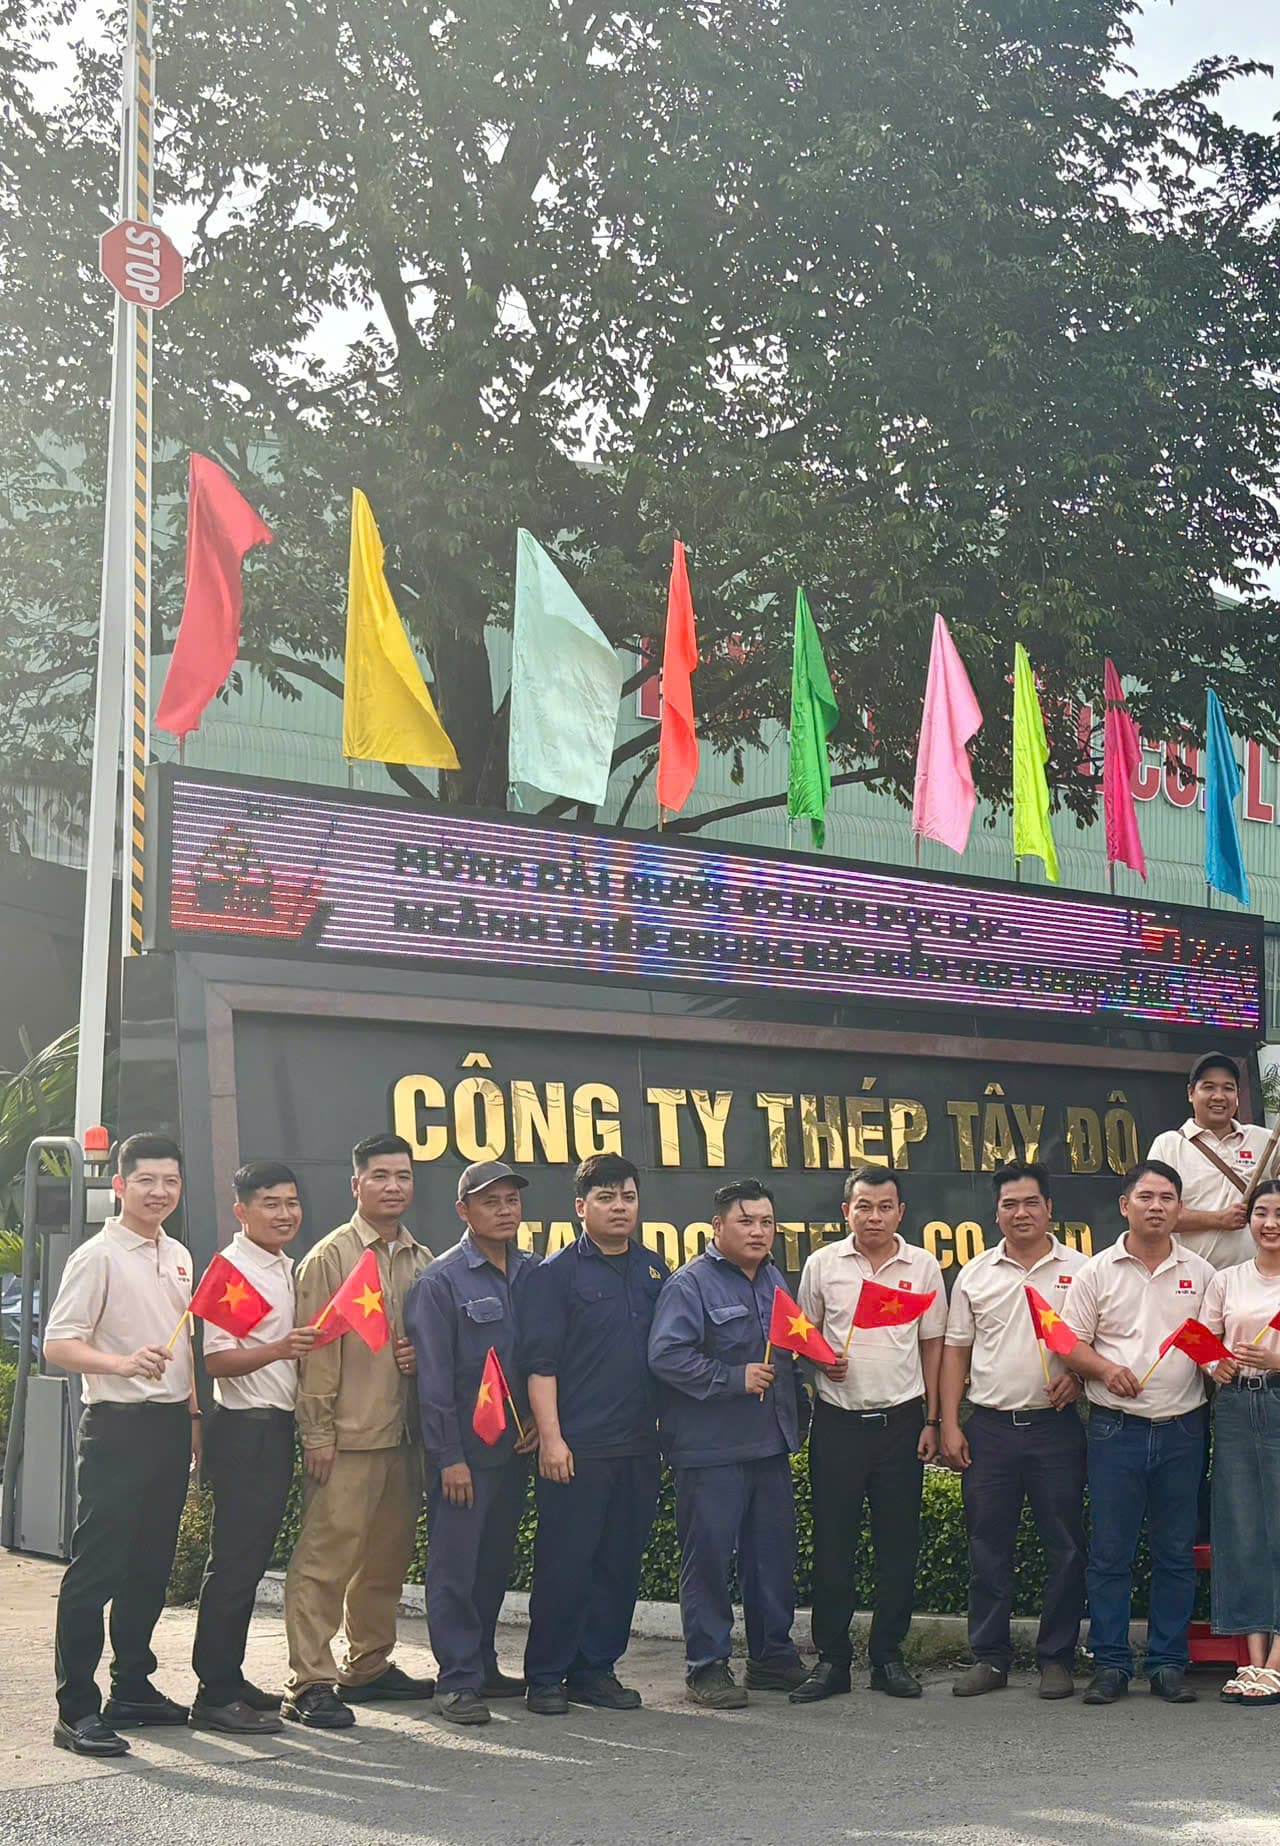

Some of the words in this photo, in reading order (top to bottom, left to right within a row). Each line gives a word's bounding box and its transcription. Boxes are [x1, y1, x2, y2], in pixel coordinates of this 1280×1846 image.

[125, 226, 160, 303] STOP
[392, 1051, 623, 1165] CÔNG
[647, 1086, 734, 1168] TY
[756, 1076, 930, 1170] THÉP
[947, 1082, 1046, 1173] TÂY
[1066, 1090, 1141, 1176] ĐÔ
